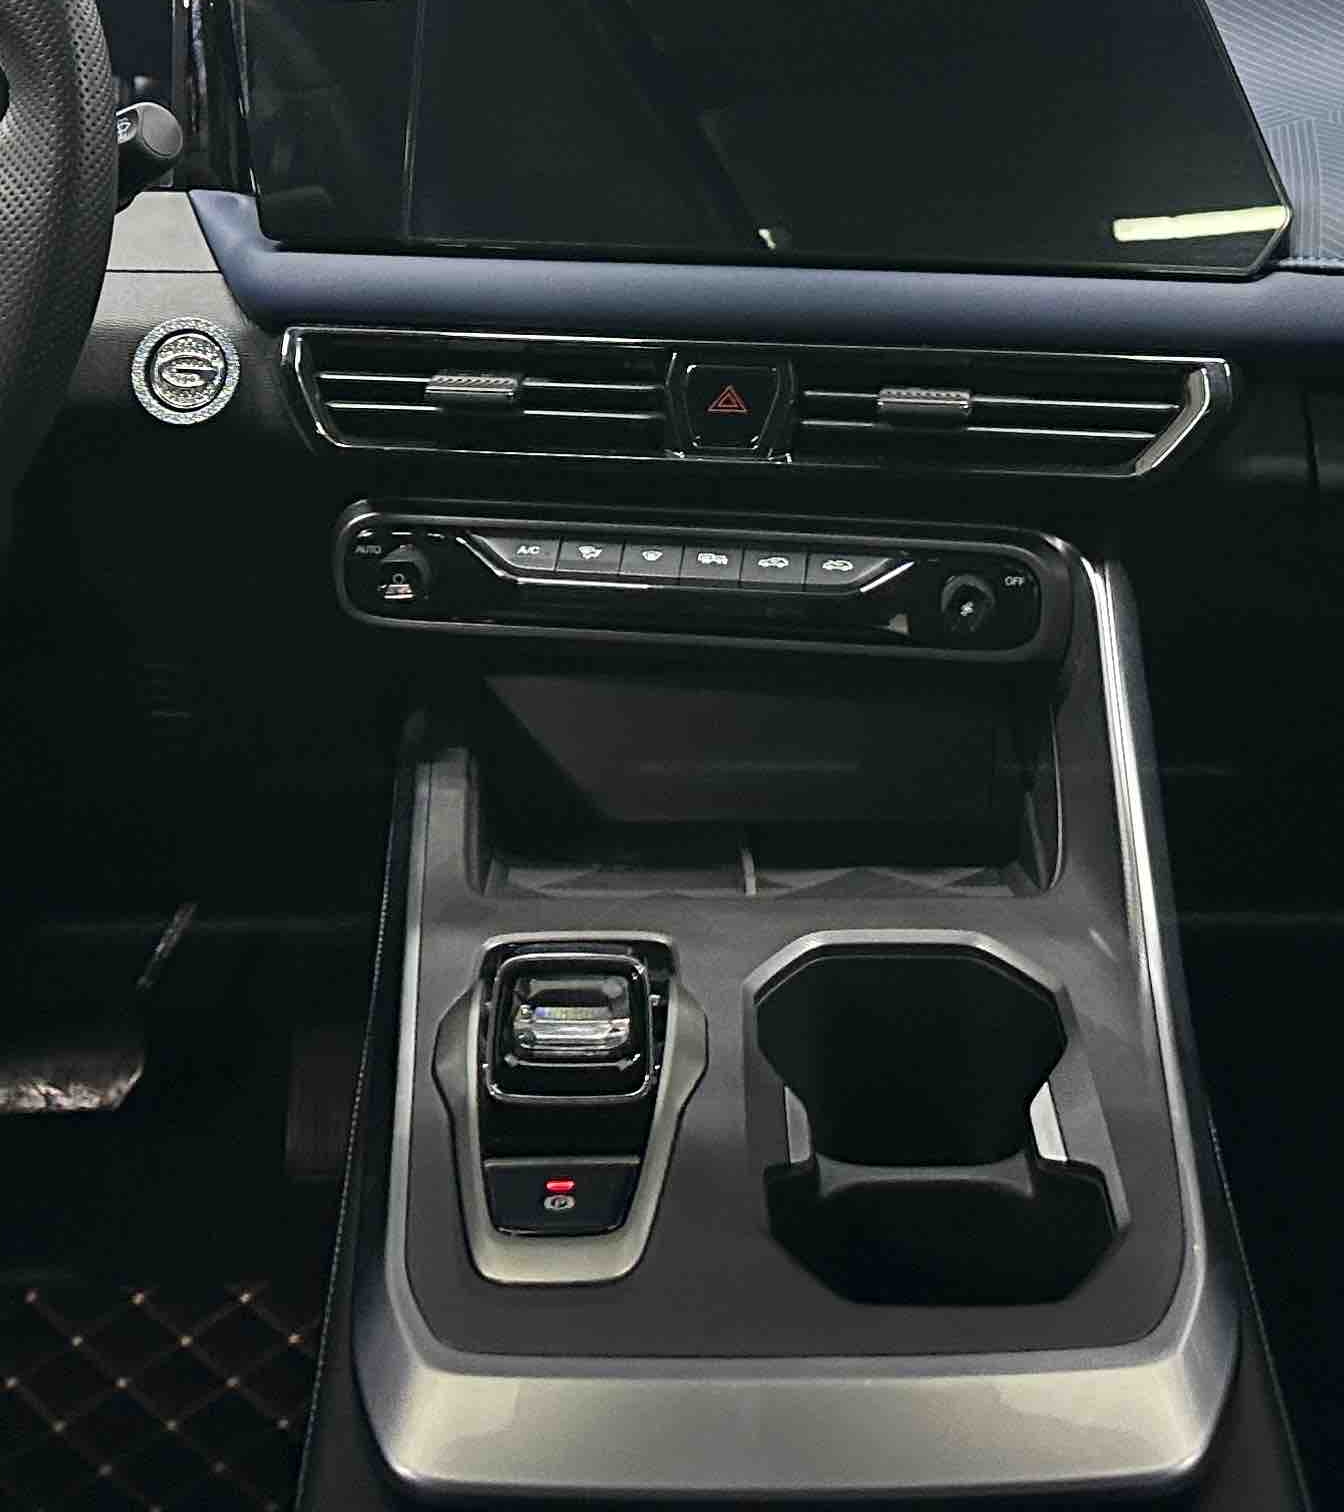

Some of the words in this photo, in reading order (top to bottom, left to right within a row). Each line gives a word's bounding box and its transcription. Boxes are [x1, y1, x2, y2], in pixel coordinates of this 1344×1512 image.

[355, 544, 383, 555] AUTO
[517, 545, 541, 555] A/C
[1004, 575, 1025, 587] OFF
